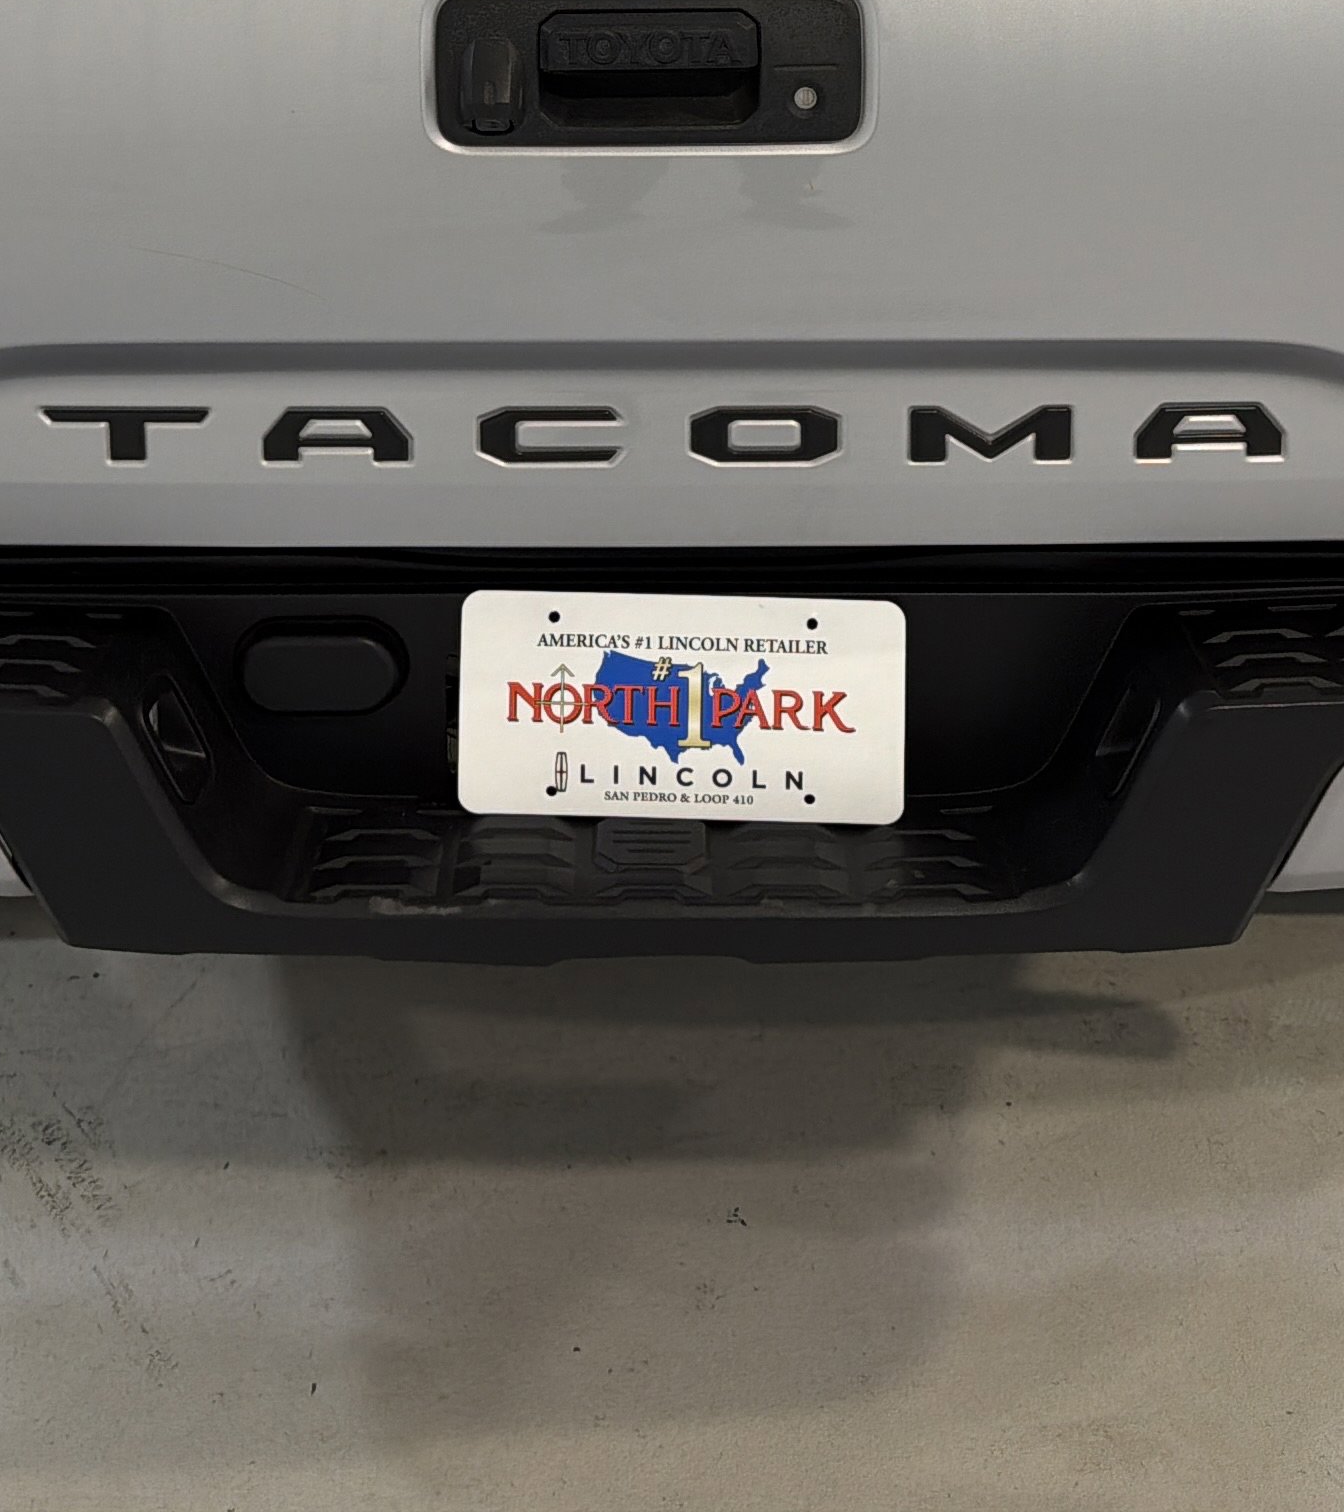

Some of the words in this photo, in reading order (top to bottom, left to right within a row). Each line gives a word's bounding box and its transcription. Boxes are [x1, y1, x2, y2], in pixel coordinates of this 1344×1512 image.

[558, 28, 743, 66] TOYOTA
[40, 402, 1288, 467] TACOMA
[537, 633, 631, 649] AMERICA'S
[635, 637, 652, 650] #1
[658, 637, 739, 652] LINCOLN
[743, 639, 828, 655] RETAILER
[507, 681, 680, 727] NORTH
[711, 688, 856, 733] PARK
[580, 764, 804, 790] LINCOLN
[604, 790, 629, 802] SAN
[633, 791, 677, 803] PEDRO
[680, 792, 690, 803] &
[694, 793, 730, 804] LOOP
[733, 793, 754, 805] 410
